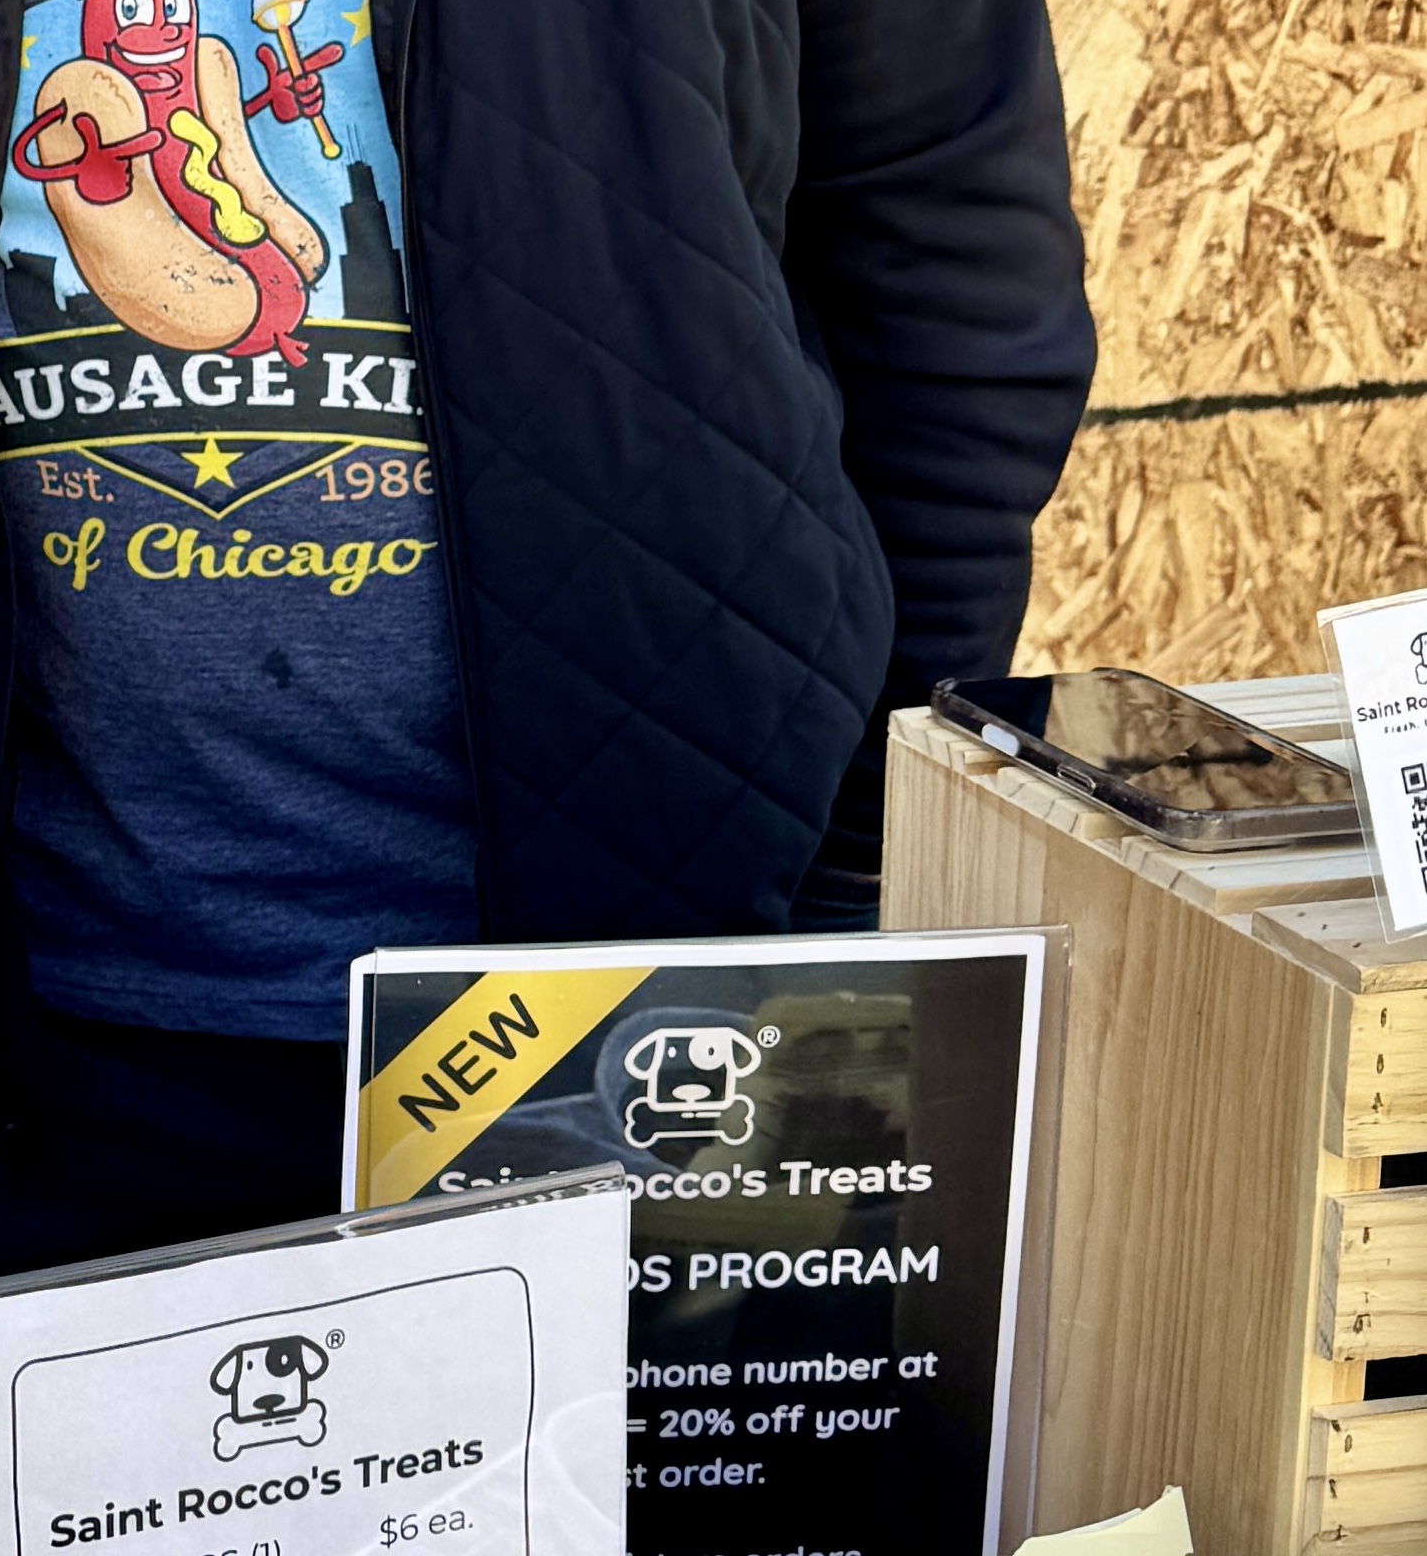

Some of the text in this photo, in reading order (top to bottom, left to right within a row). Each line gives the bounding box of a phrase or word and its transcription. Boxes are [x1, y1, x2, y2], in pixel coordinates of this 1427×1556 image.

[36, 460, 113, 503] Est.
[43, 517, 438, 597] of Chicago
[1357, 701, 1401, 722] Saint
[398, 993, 539, 1132] NEW
[628, 1160, 932, 1201] occo's Treats
[689, 1245, 939, 1290] PROGRAM
[744, 1352, 938, 1384] number at
[659, 1404, 900, 1439] 20% off your
[659, 1457, 765, 1487] order.
[51, 1440, 483, 1548] Saint Rocco's Treats
